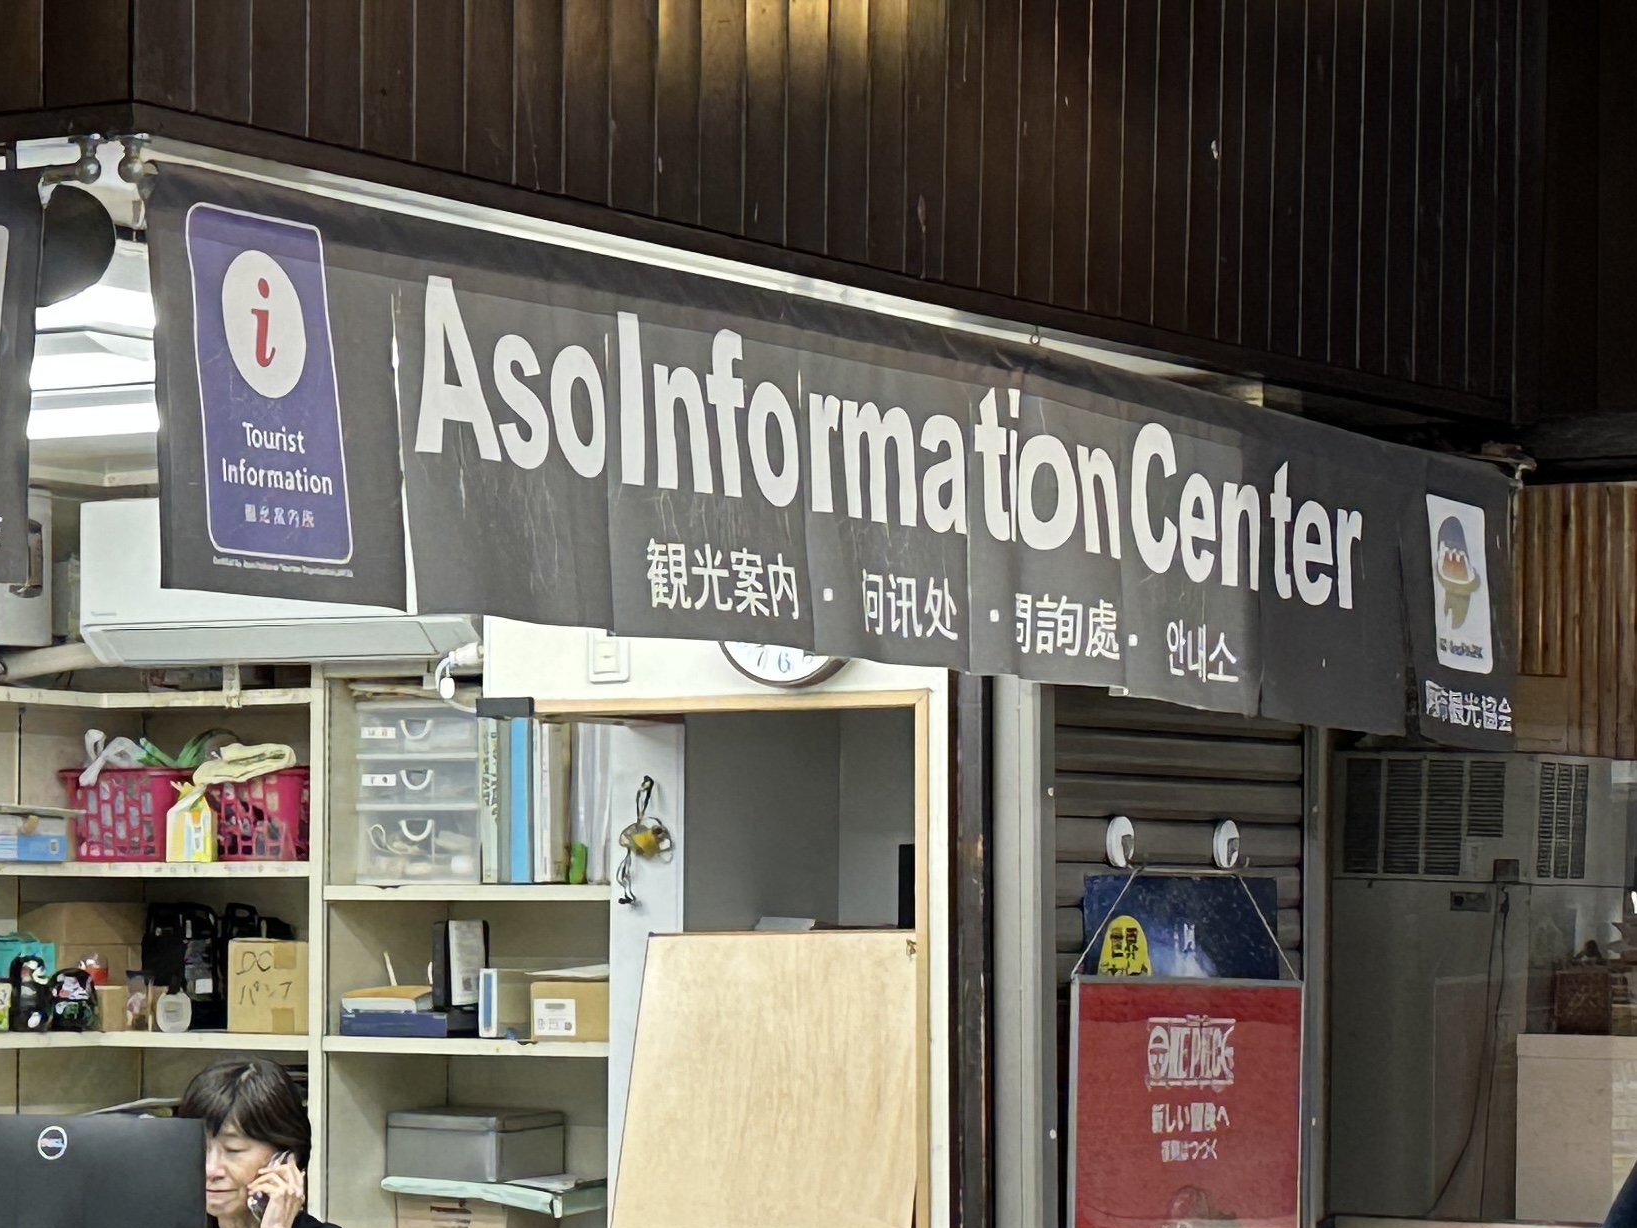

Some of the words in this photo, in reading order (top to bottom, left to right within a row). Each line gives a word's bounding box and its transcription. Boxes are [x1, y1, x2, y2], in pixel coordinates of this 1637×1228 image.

[242, 421, 305, 454] Tourist
[415, 275, 605, 478] Aso
[617, 311, 1121, 560] Information
[1130, 421, 1362, 610] Center
[222, 457, 333, 495] Information
[647, 538, 799, 620] 観光案内
[1166, 619, 1240, 683] 안내소
